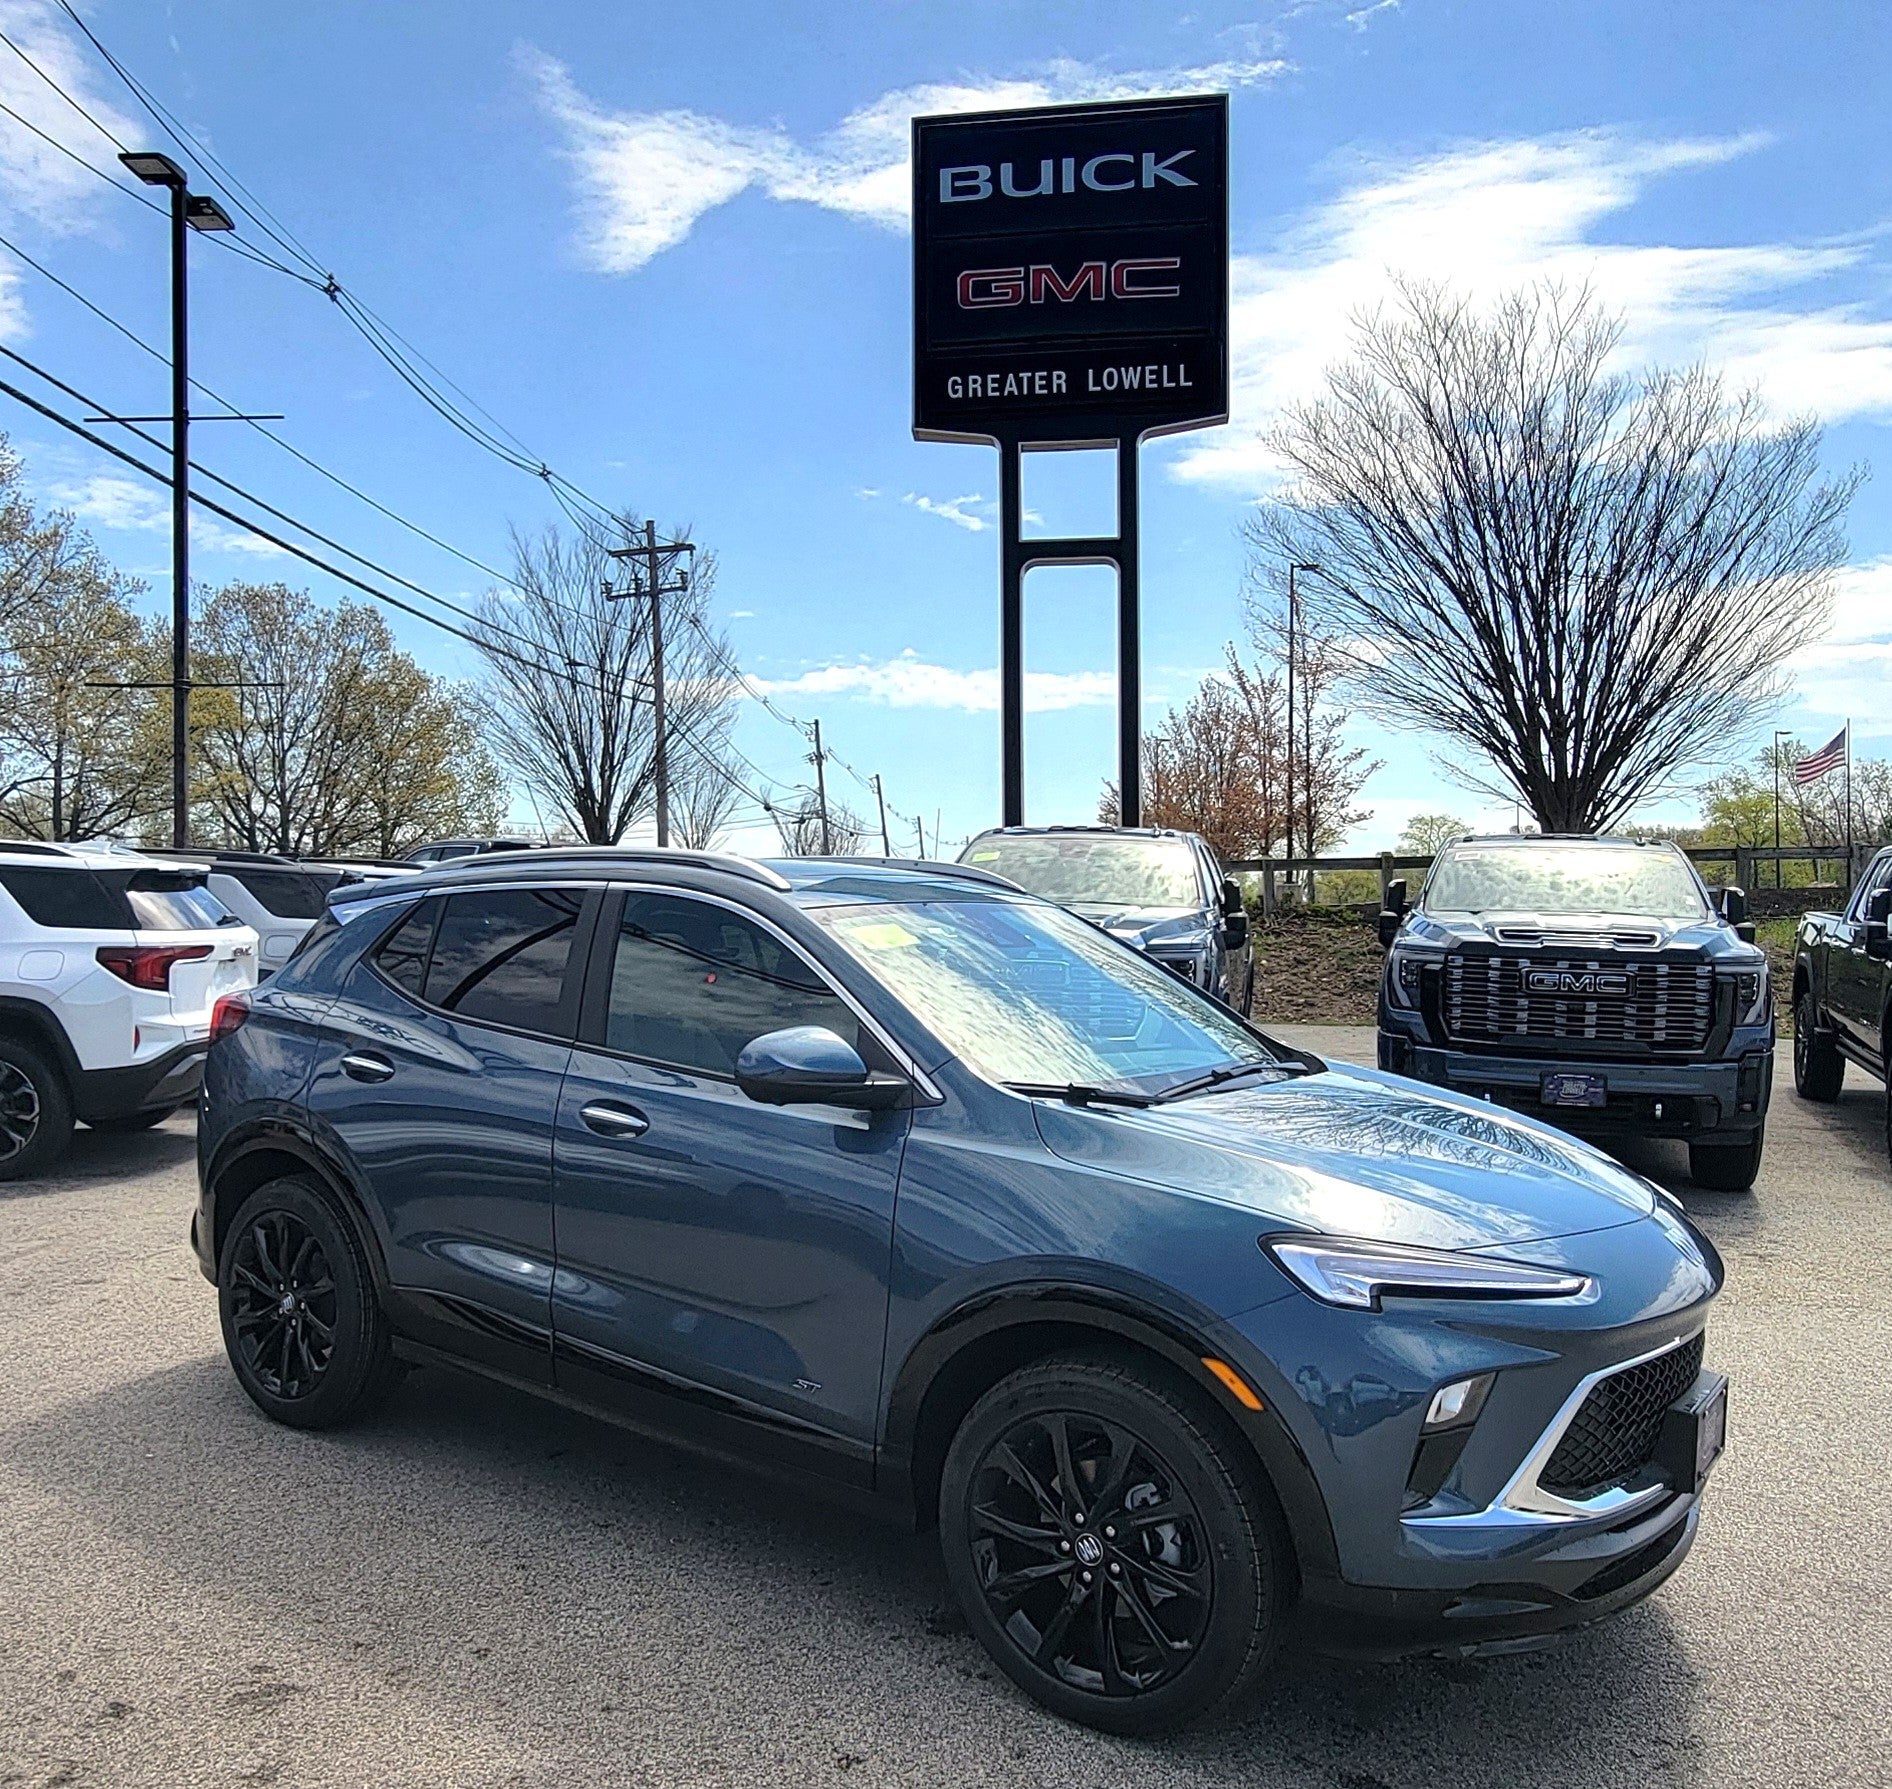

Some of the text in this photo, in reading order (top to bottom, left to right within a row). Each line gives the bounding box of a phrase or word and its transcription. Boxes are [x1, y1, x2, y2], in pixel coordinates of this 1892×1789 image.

[939, 150, 1199, 203] BUICK
[957, 257, 1181, 310] GMC
[947, 364, 1193, 399] GREATER LOWELL
[1529, 972, 1627, 993] GMC
